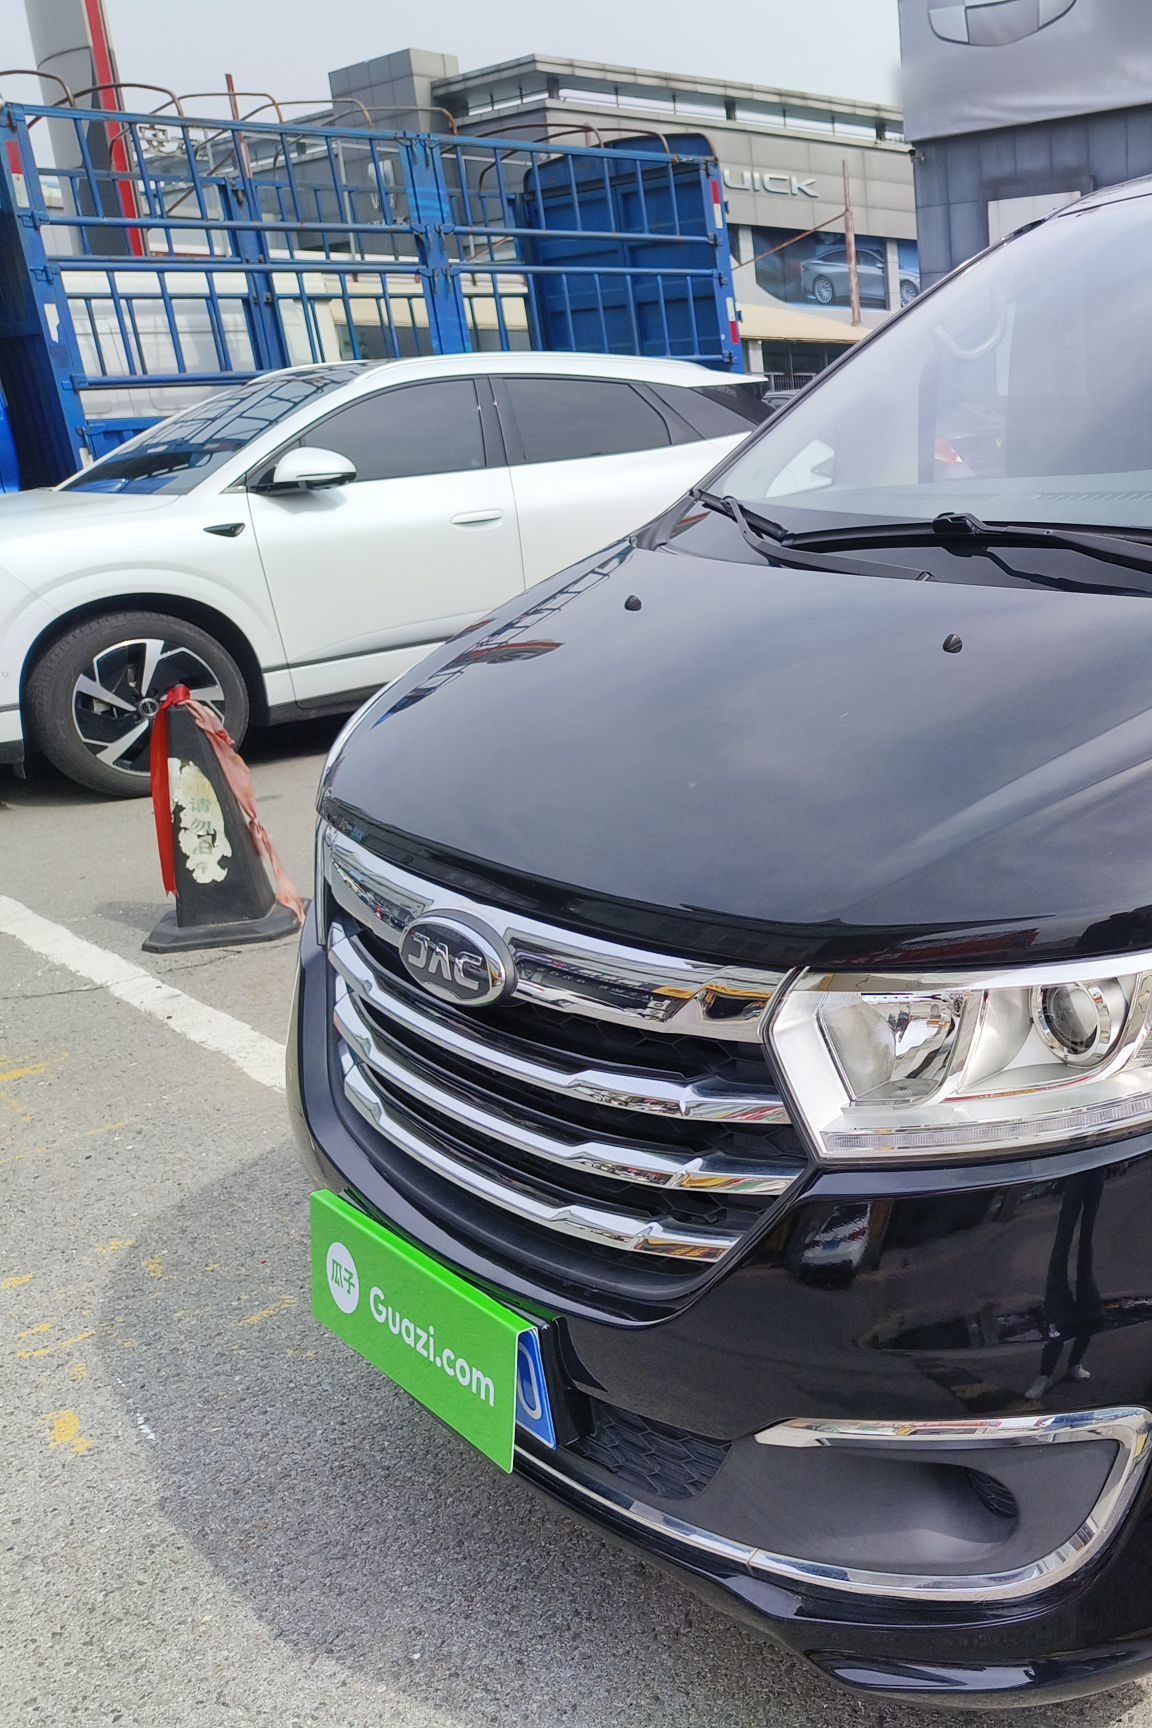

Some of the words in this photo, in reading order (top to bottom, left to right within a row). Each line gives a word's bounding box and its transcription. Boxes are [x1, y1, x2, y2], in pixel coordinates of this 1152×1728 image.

[722, 168, 819, 199] UICK
[407, 931, 483, 992] JAC
[331, 1258, 357, 1296] 瓜子
[369, 1286, 496, 1408] Guazi.com
